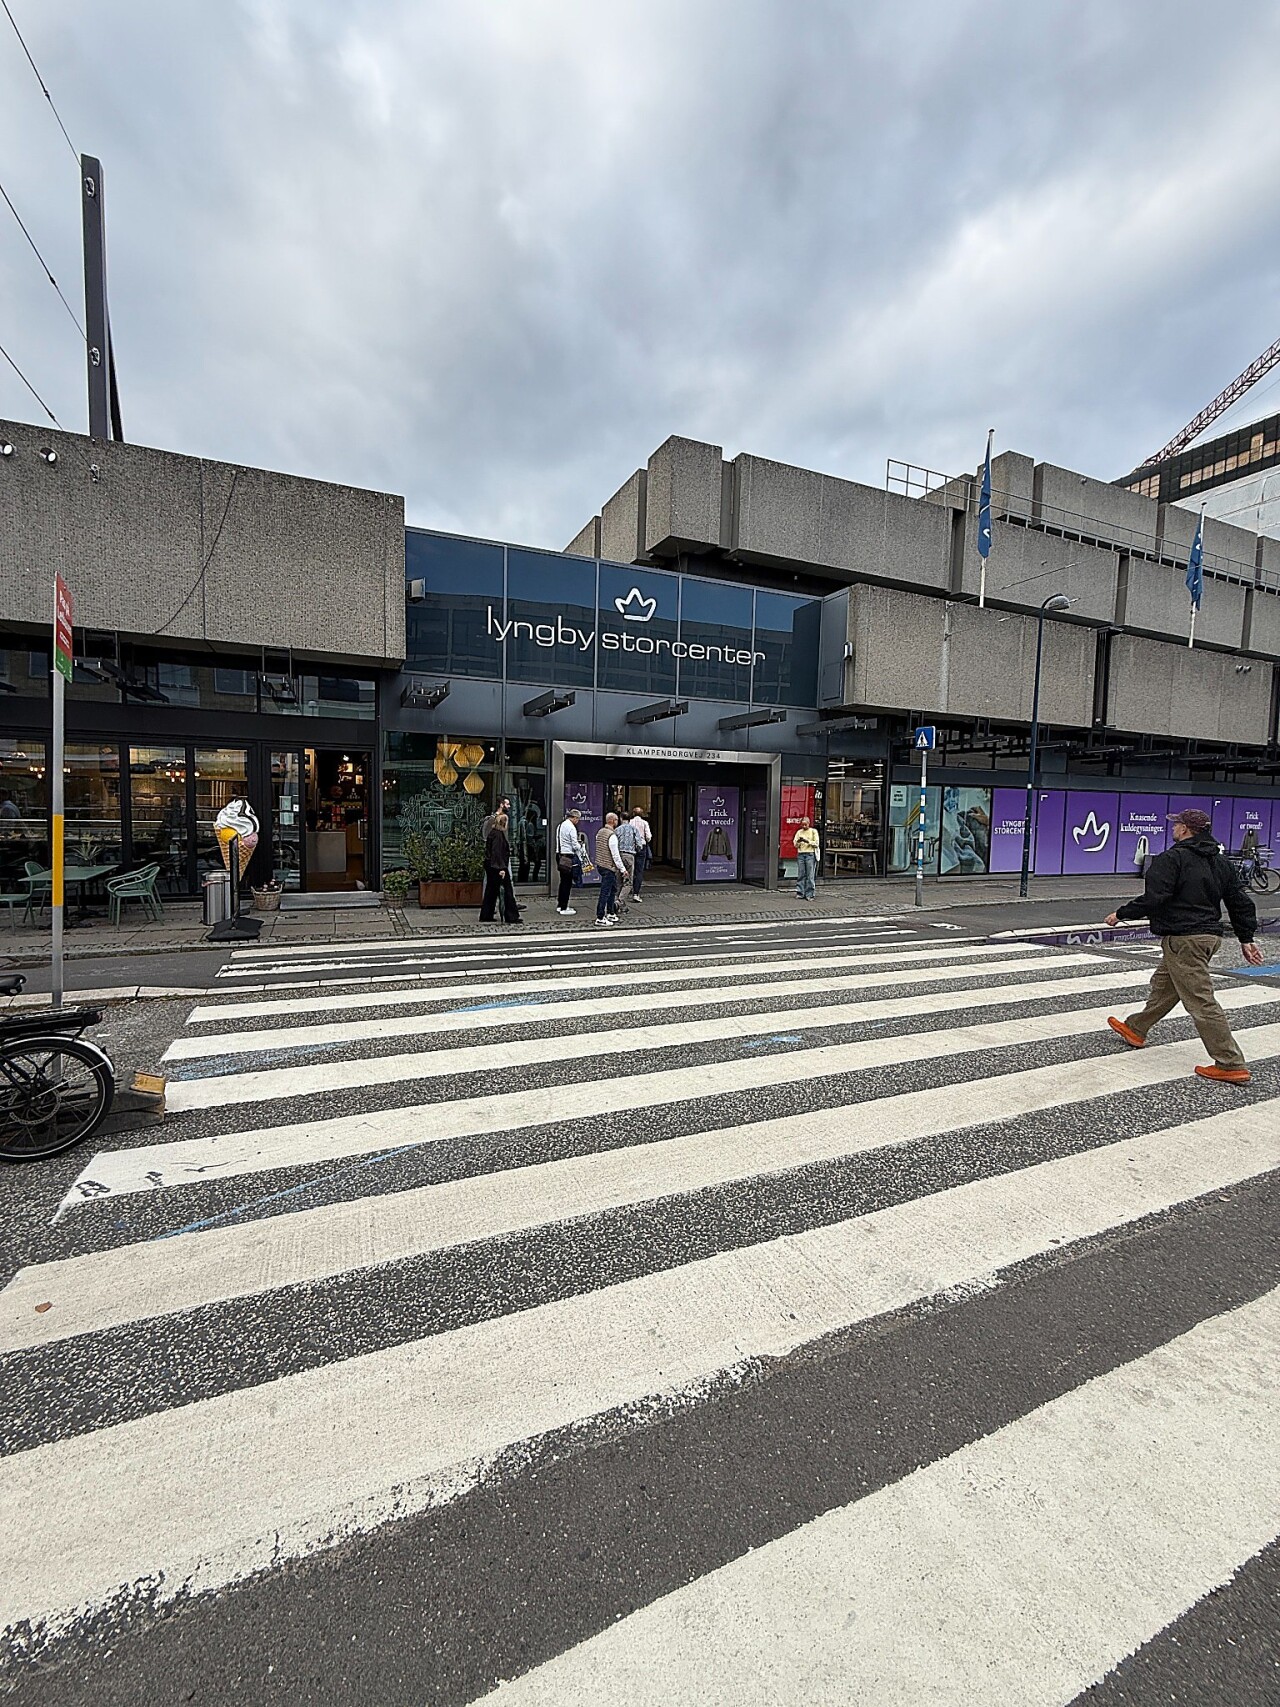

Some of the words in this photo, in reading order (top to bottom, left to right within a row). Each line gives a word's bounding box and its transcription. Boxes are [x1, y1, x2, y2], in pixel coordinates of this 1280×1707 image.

[487, 605, 595, 650] lyngby
[601, 631, 766, 666] storcenter
[626, 748, 703, 759] KLAMPENBORGVEJ
[708, 808, 728, 817] Trick
[1130, 812, 1157, 822] Knasende
[711, 818, 734, 826] tweed?
[1002, 820, 1025, 828] LYNGBY
[994, 827, 1033, 835] STORCENTR
